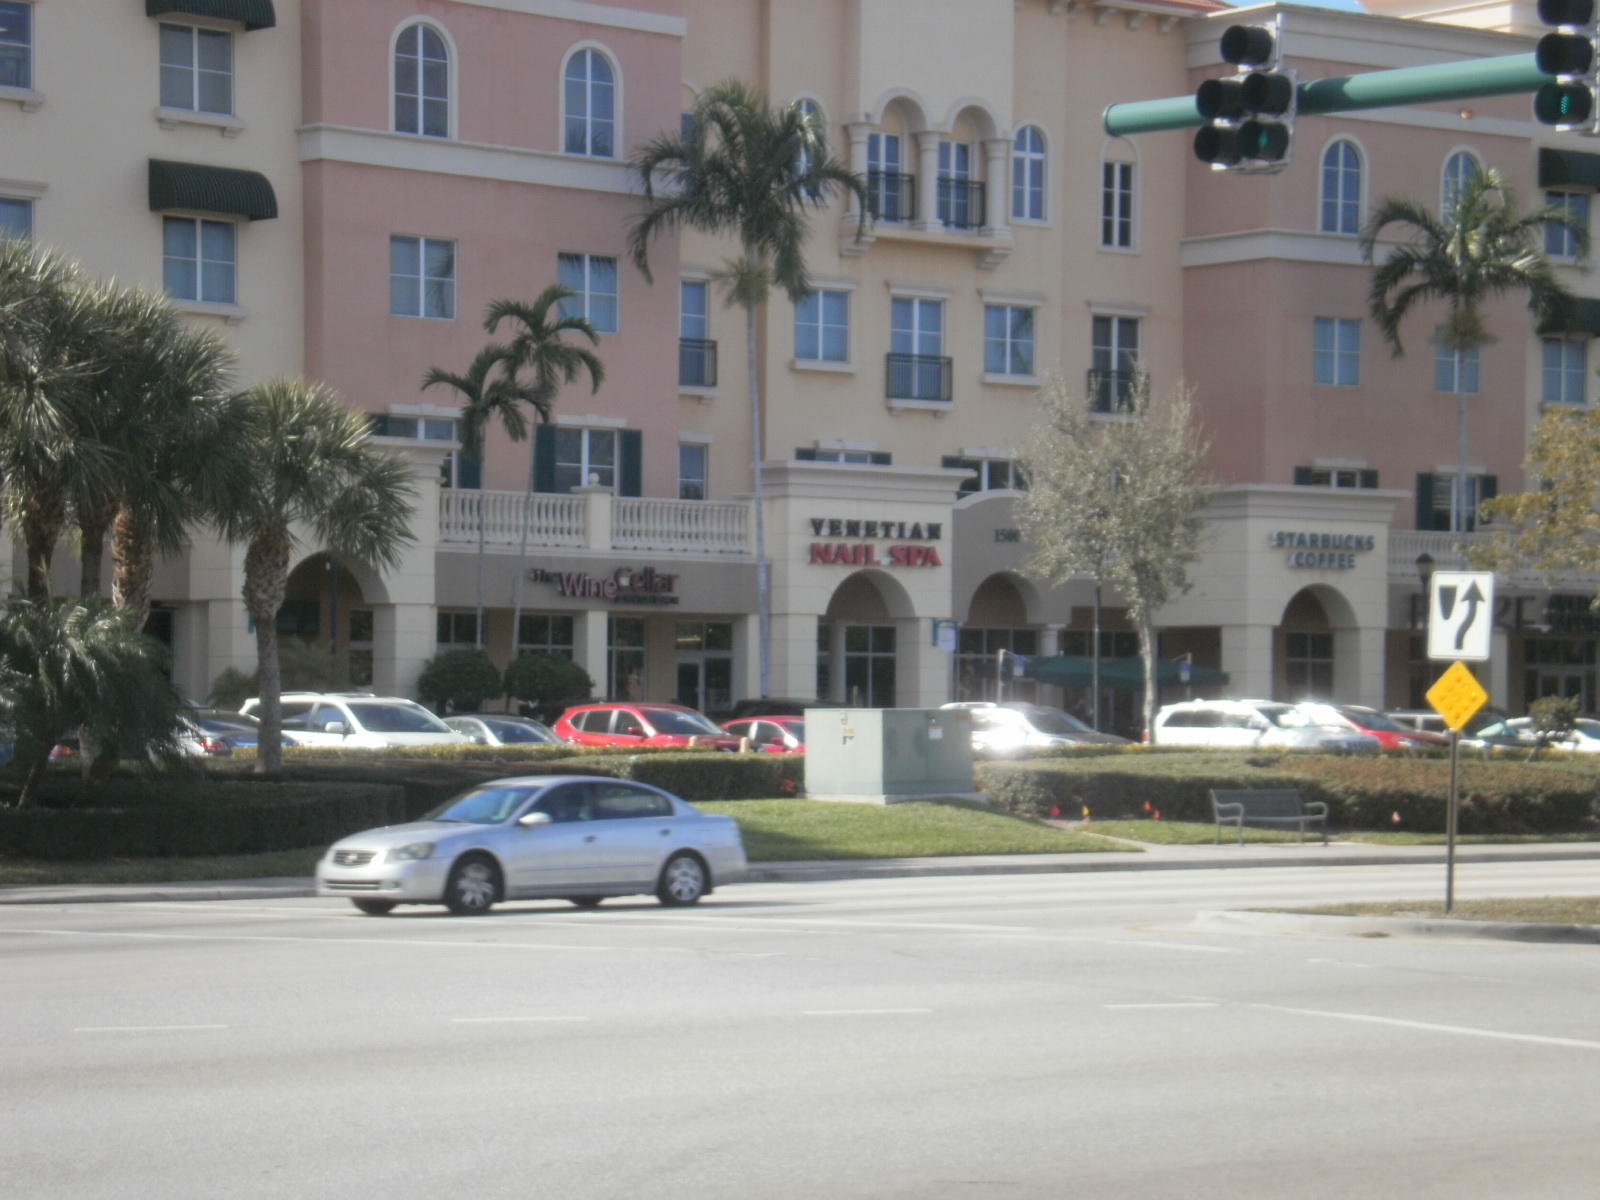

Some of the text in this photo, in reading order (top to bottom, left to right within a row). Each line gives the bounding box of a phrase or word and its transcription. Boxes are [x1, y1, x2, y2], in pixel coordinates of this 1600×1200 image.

[809, 518, 942, 540] VENETIAN
[1270, 532, 1375, 551] STARBUCKS
[808, 543, 942, 567] NAIL SPA
[1288, 552, 1357, 569] COFFEE
[558, 570, 618, 599] Wine
[614, 566, 679, 593] Cellar
